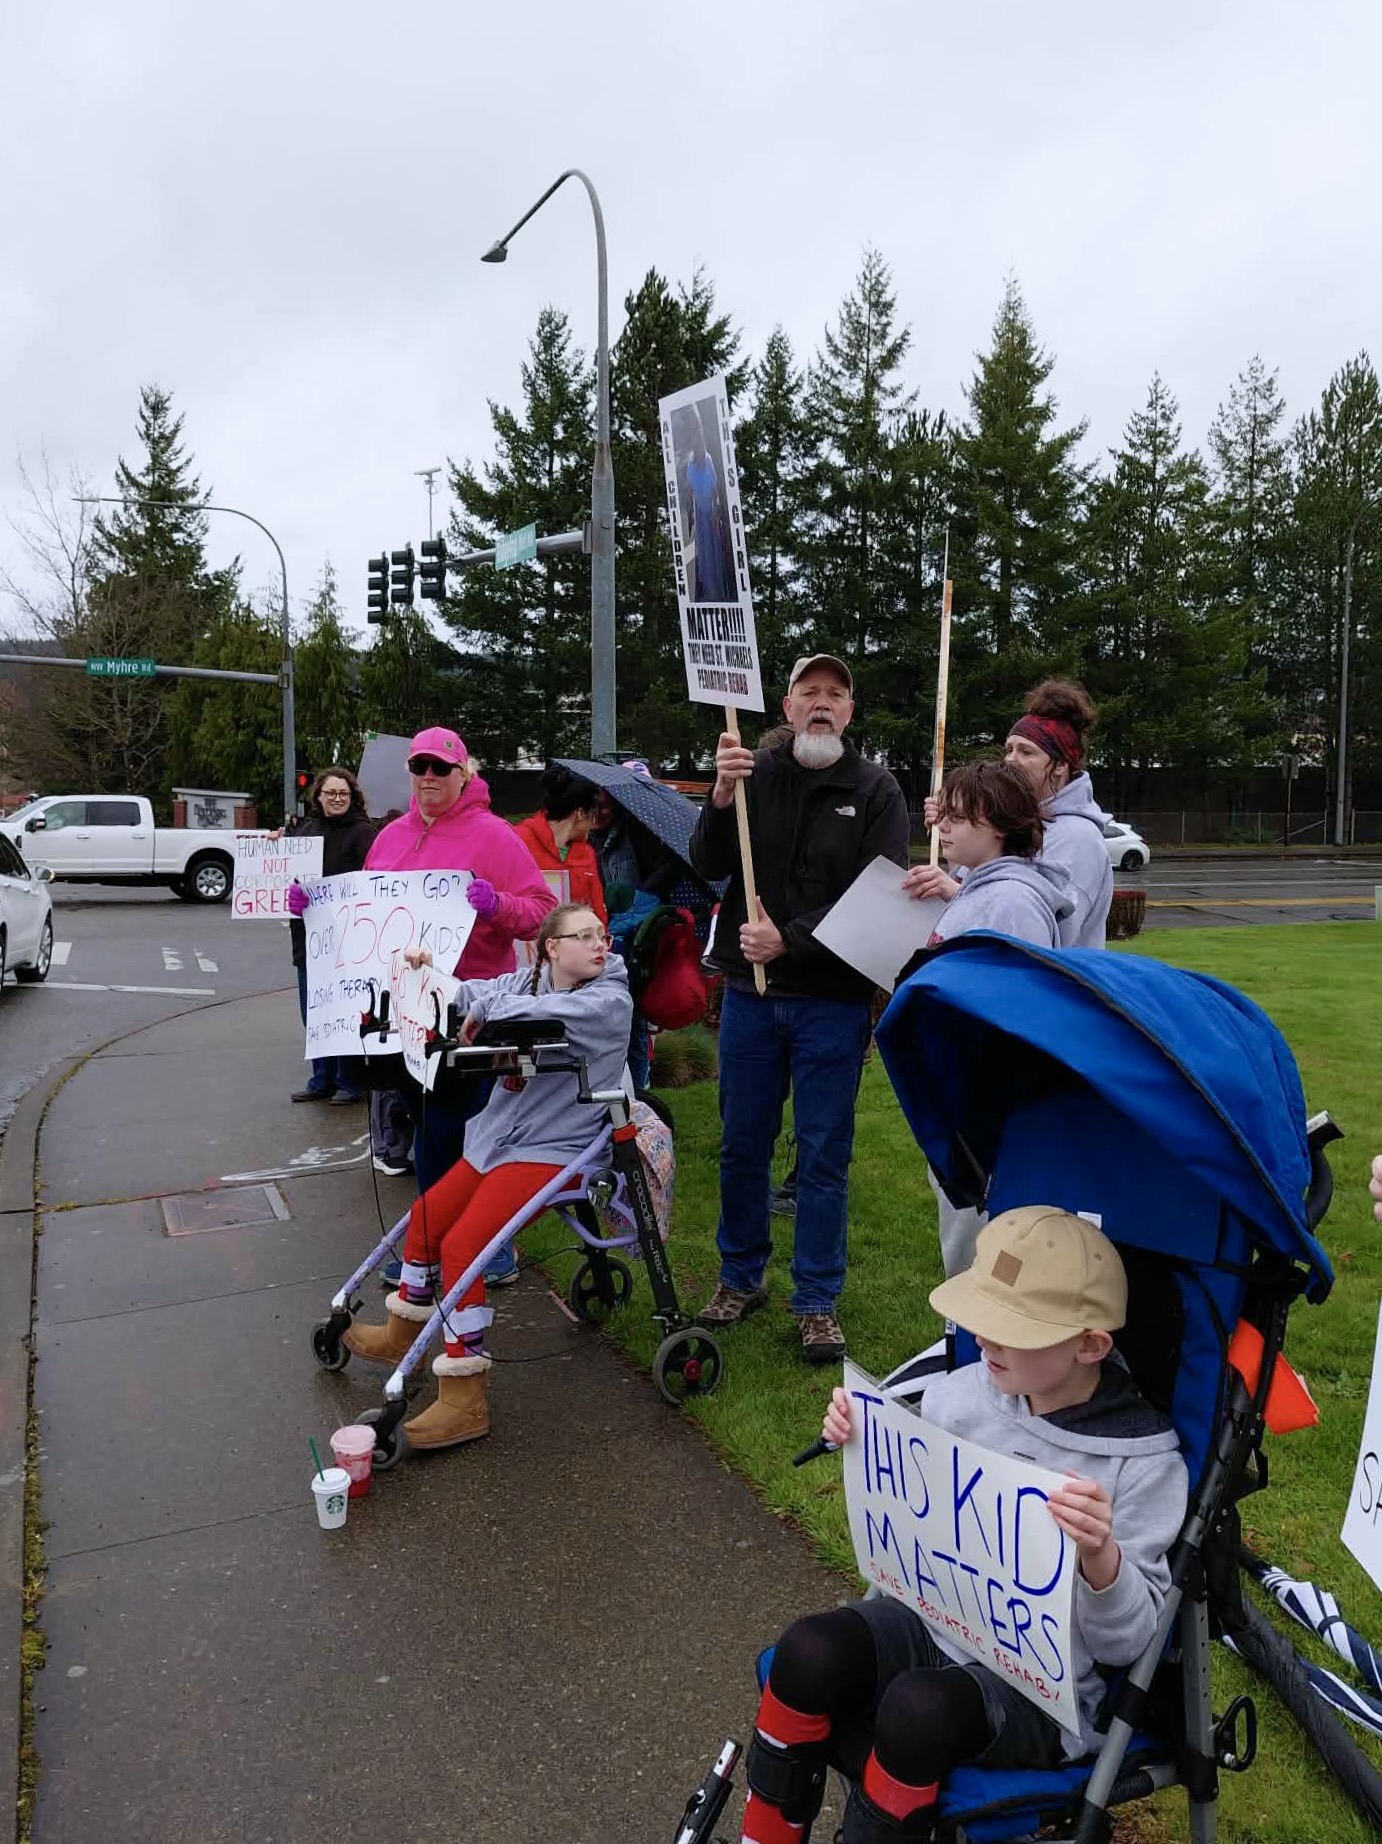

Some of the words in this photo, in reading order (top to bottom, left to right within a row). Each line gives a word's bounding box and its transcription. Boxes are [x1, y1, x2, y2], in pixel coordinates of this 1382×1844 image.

[662, 420, 672, 464] ALL
[718, 399, 736, 488] THIS
[667, 480, 687, 596] CHILDREN
[731, 505, 748, 592] GIRL
[686, 607, 746, 642] MATTER!!!!
[107, 660, 139, 676] Myhre
[238, 838, 280, 859] HUMAN
[284, 838, 313, 855] NEED
[263, 857, 292, 874] NOT
[235, 889, 291, 915] GREE
[369, 875, 409, 898] THEY
[335, 903, 415, 969] 250
[418, 921, 467, 955] KIDS
[851, 1390, 930, 1520] THIS
[952, 1445, 1065, 1597] KID
[865, 1509, 1065, 1683] MATTERS
[869, 1561, 905, 1597] SAVE
[915, 1596, 986, 1655] PEDIATRIC
[992, 1646, 1062, 1702] REHAB!
